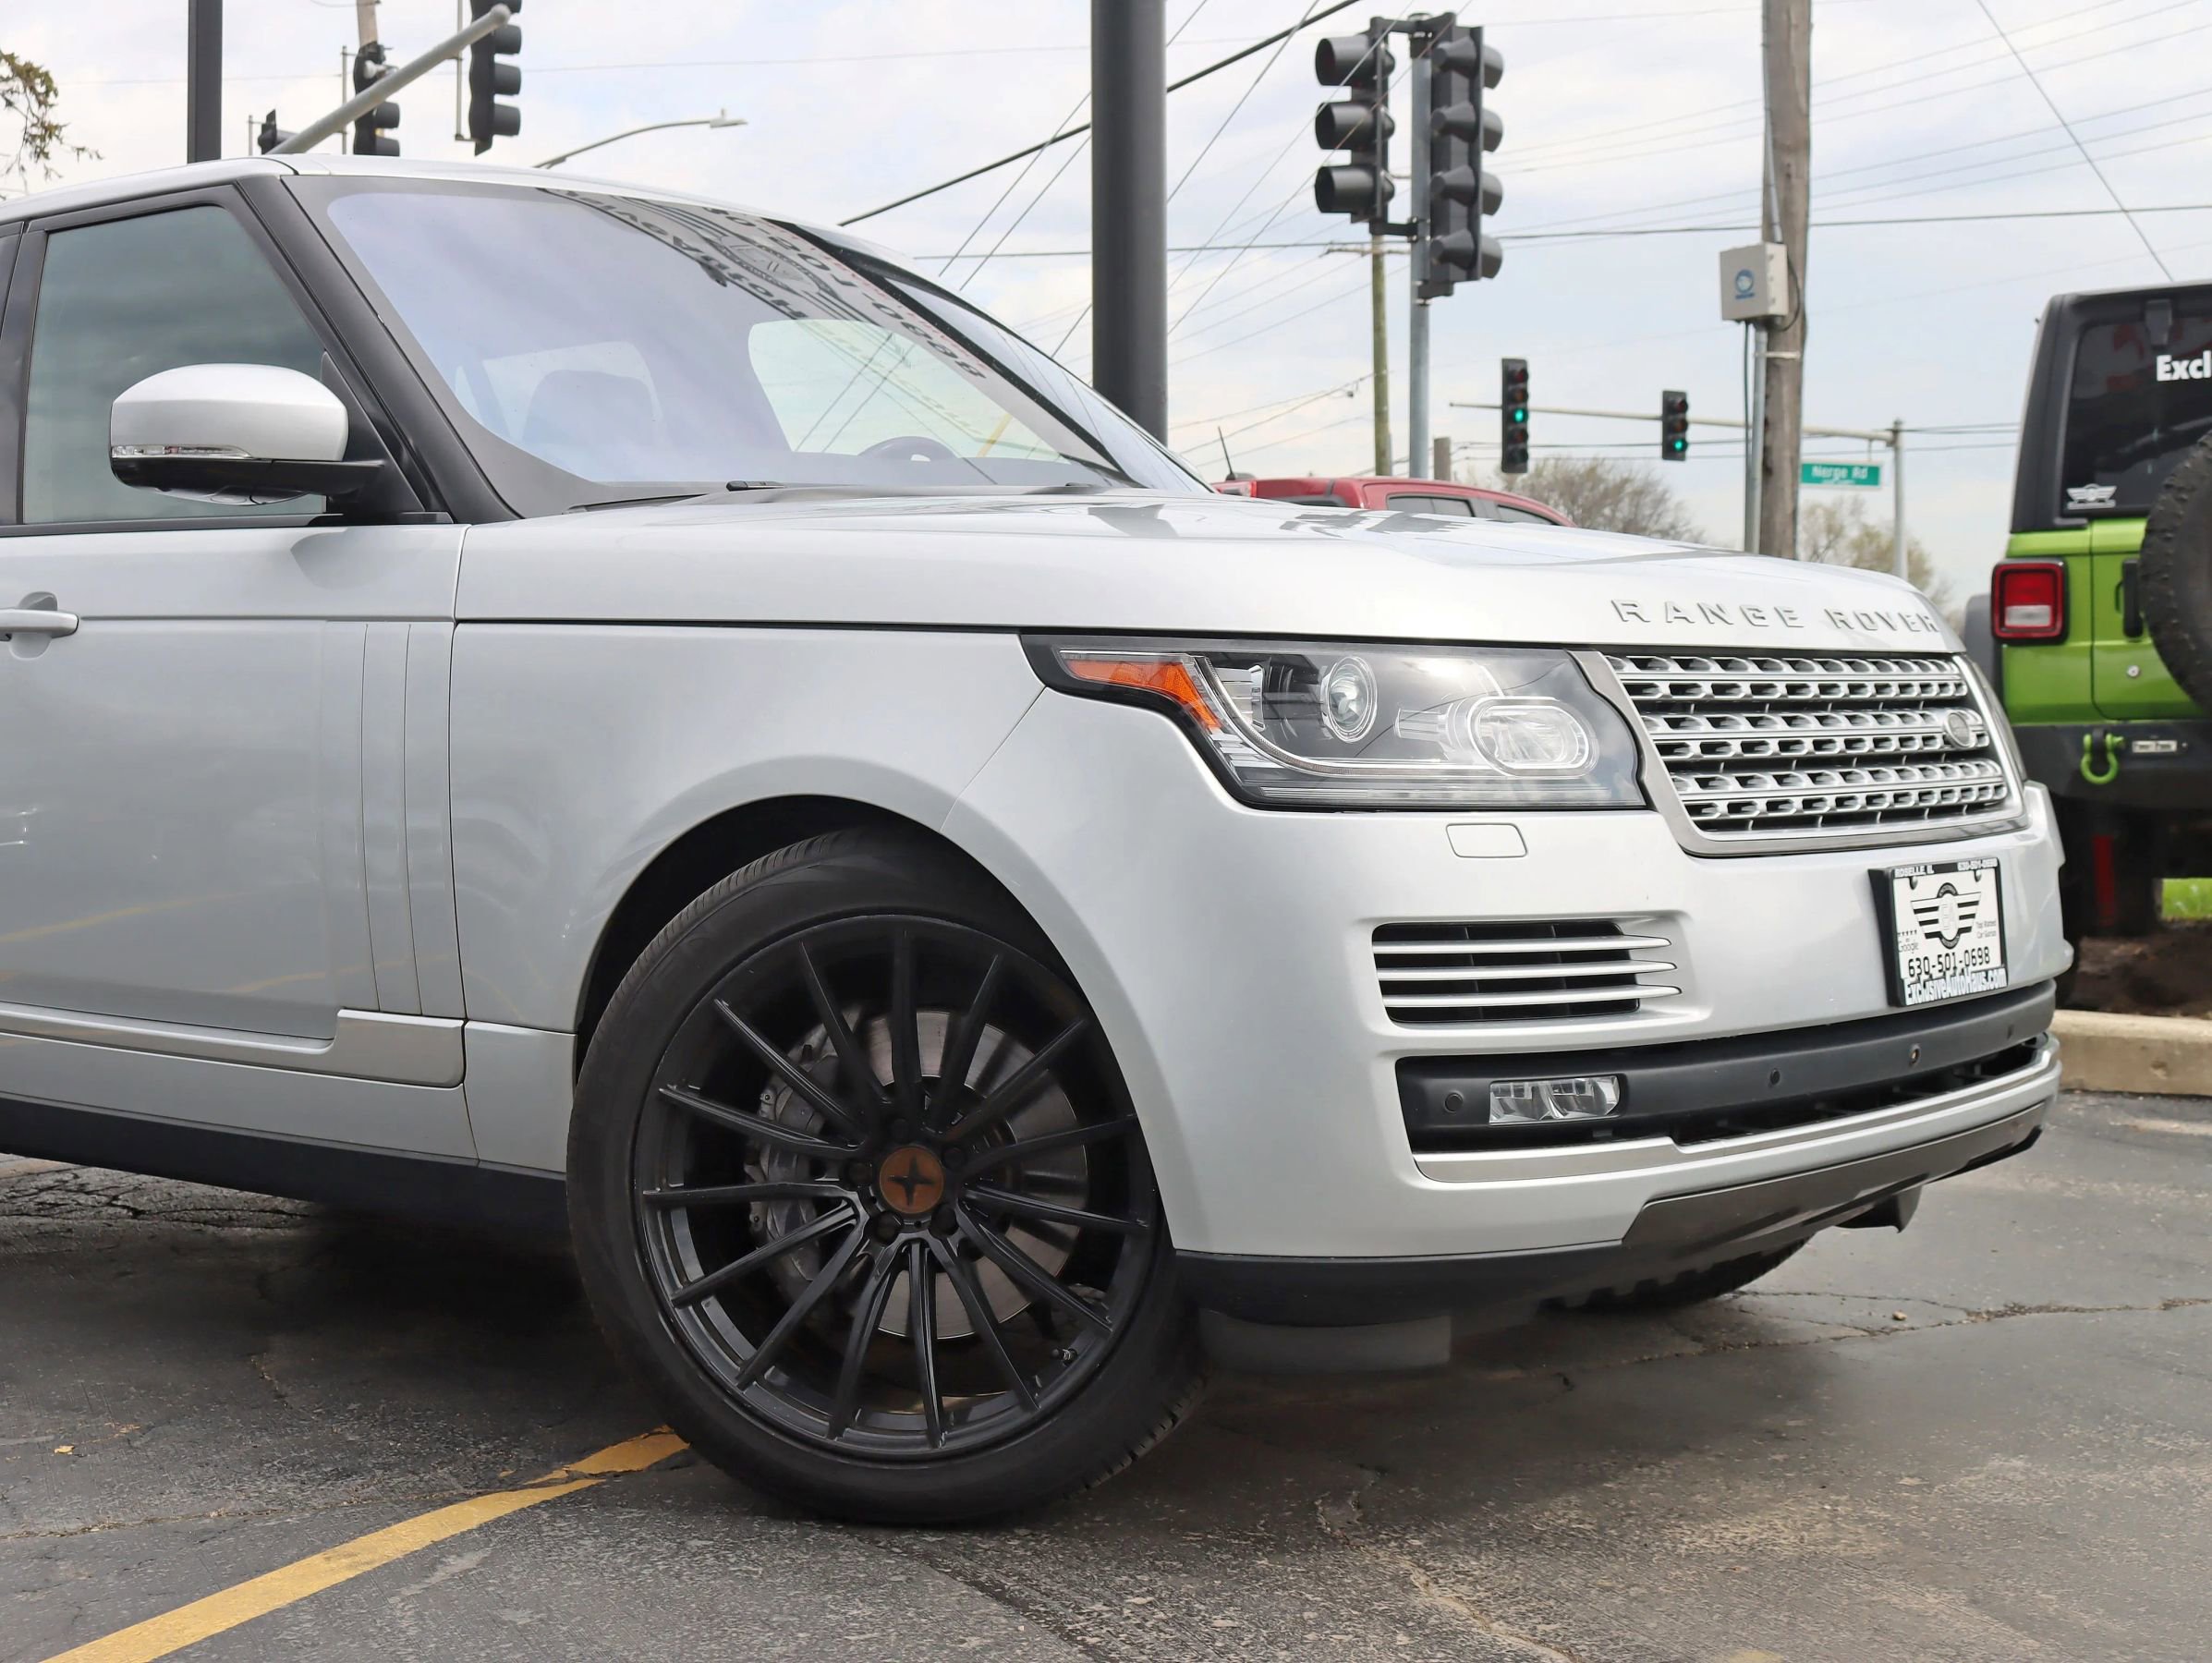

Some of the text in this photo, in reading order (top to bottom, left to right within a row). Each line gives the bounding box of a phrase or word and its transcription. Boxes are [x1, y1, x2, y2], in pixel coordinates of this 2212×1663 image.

[2157, 350, 2212, 382] Excl
[1611, 600, 1939, 633] RANGE ROVER
[1908, 946, 1990, 977] 630-501-0698
[1904, 966, 2008, 1005] ExclusiveAutoHaus.com
